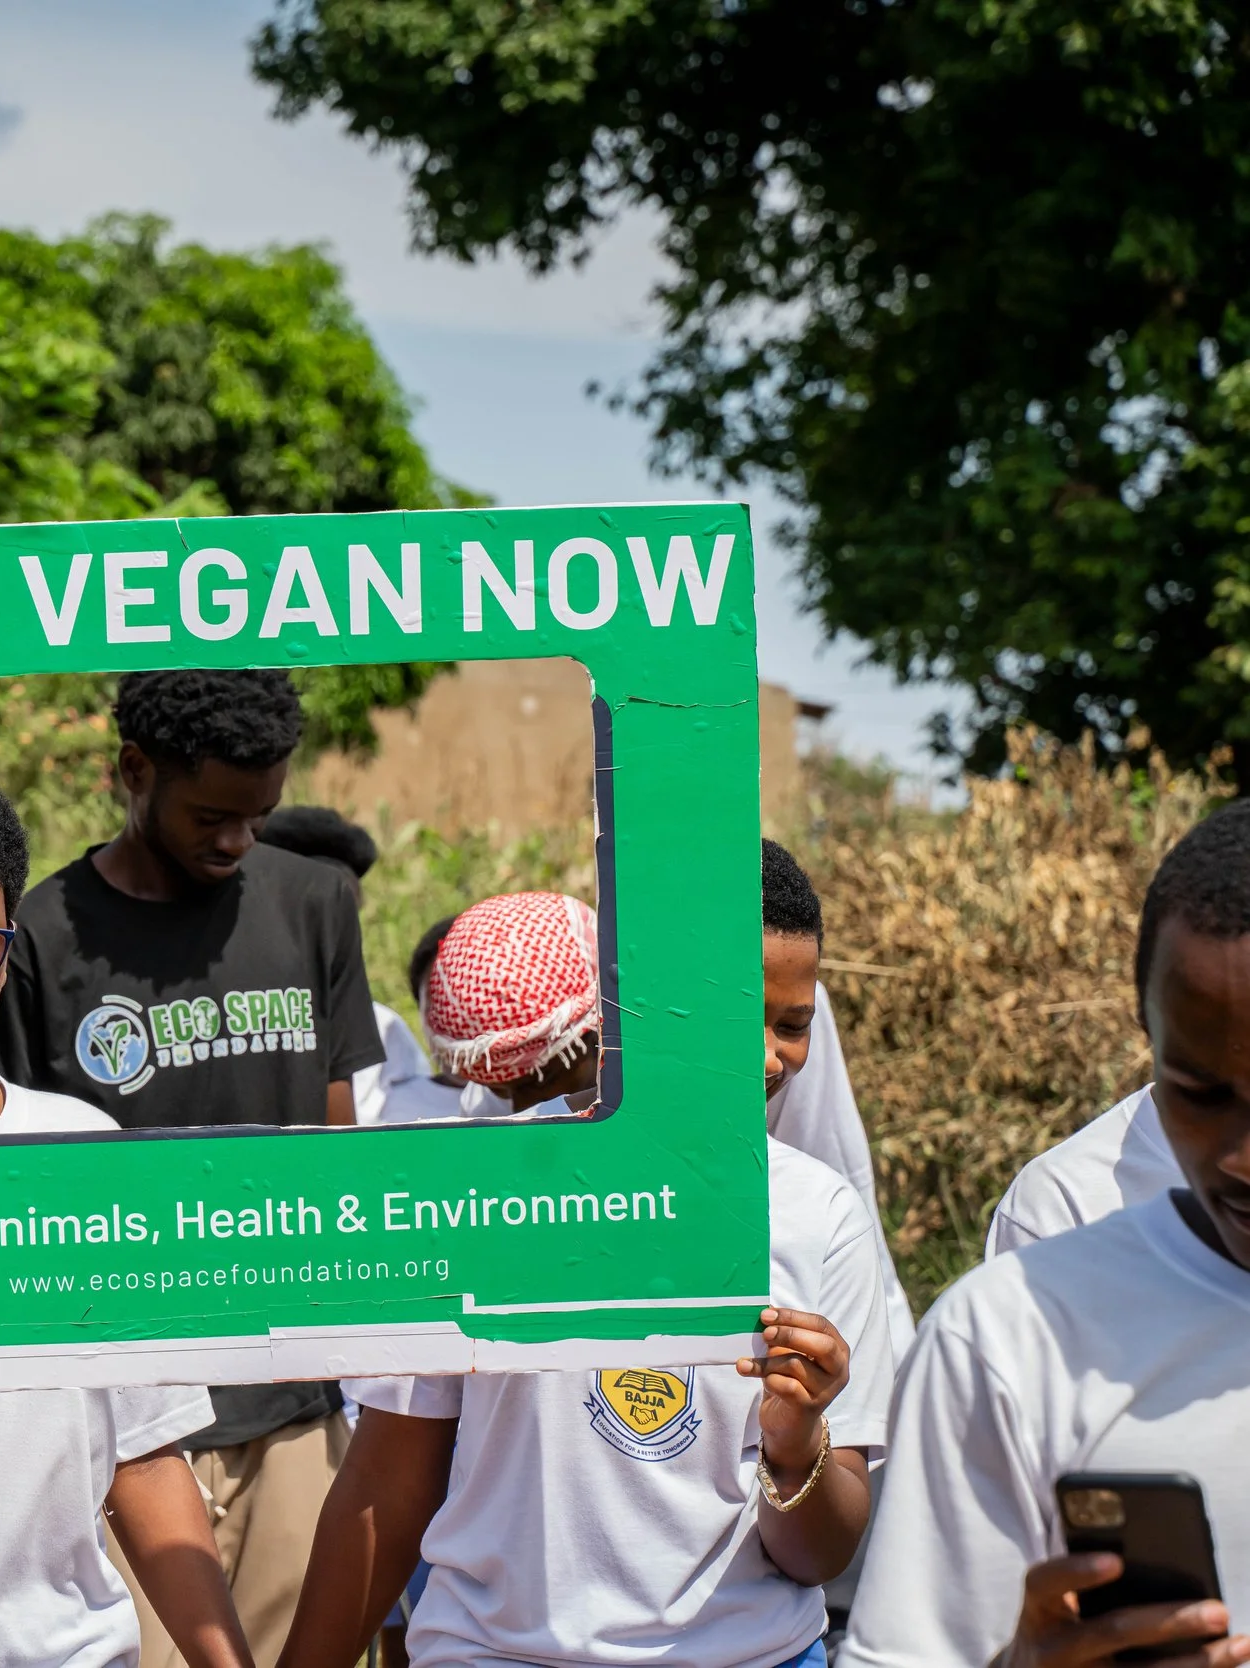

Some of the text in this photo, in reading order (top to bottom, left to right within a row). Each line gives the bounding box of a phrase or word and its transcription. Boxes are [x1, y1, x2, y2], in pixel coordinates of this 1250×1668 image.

[18, 542, 423, 646] VEGAN
[461, 534, 736, 632] NOW
[148, 986, 315, 1049] ECO SPACE
[176, 1197, 322, 1240] Health
[336, 1194, 368, 1233] &
[383, 1184, 676, 1231] Environment
[9, 1256, 450, 1294] www.ecospacefoundation.org
[624, 1390, 666, 1409] BAJJA
[595, 1418, 624, 1446] EDUCATION
[624, 1443, 636, 1453] FOR
[662, 1434, 691, 1454] TOMORROW
